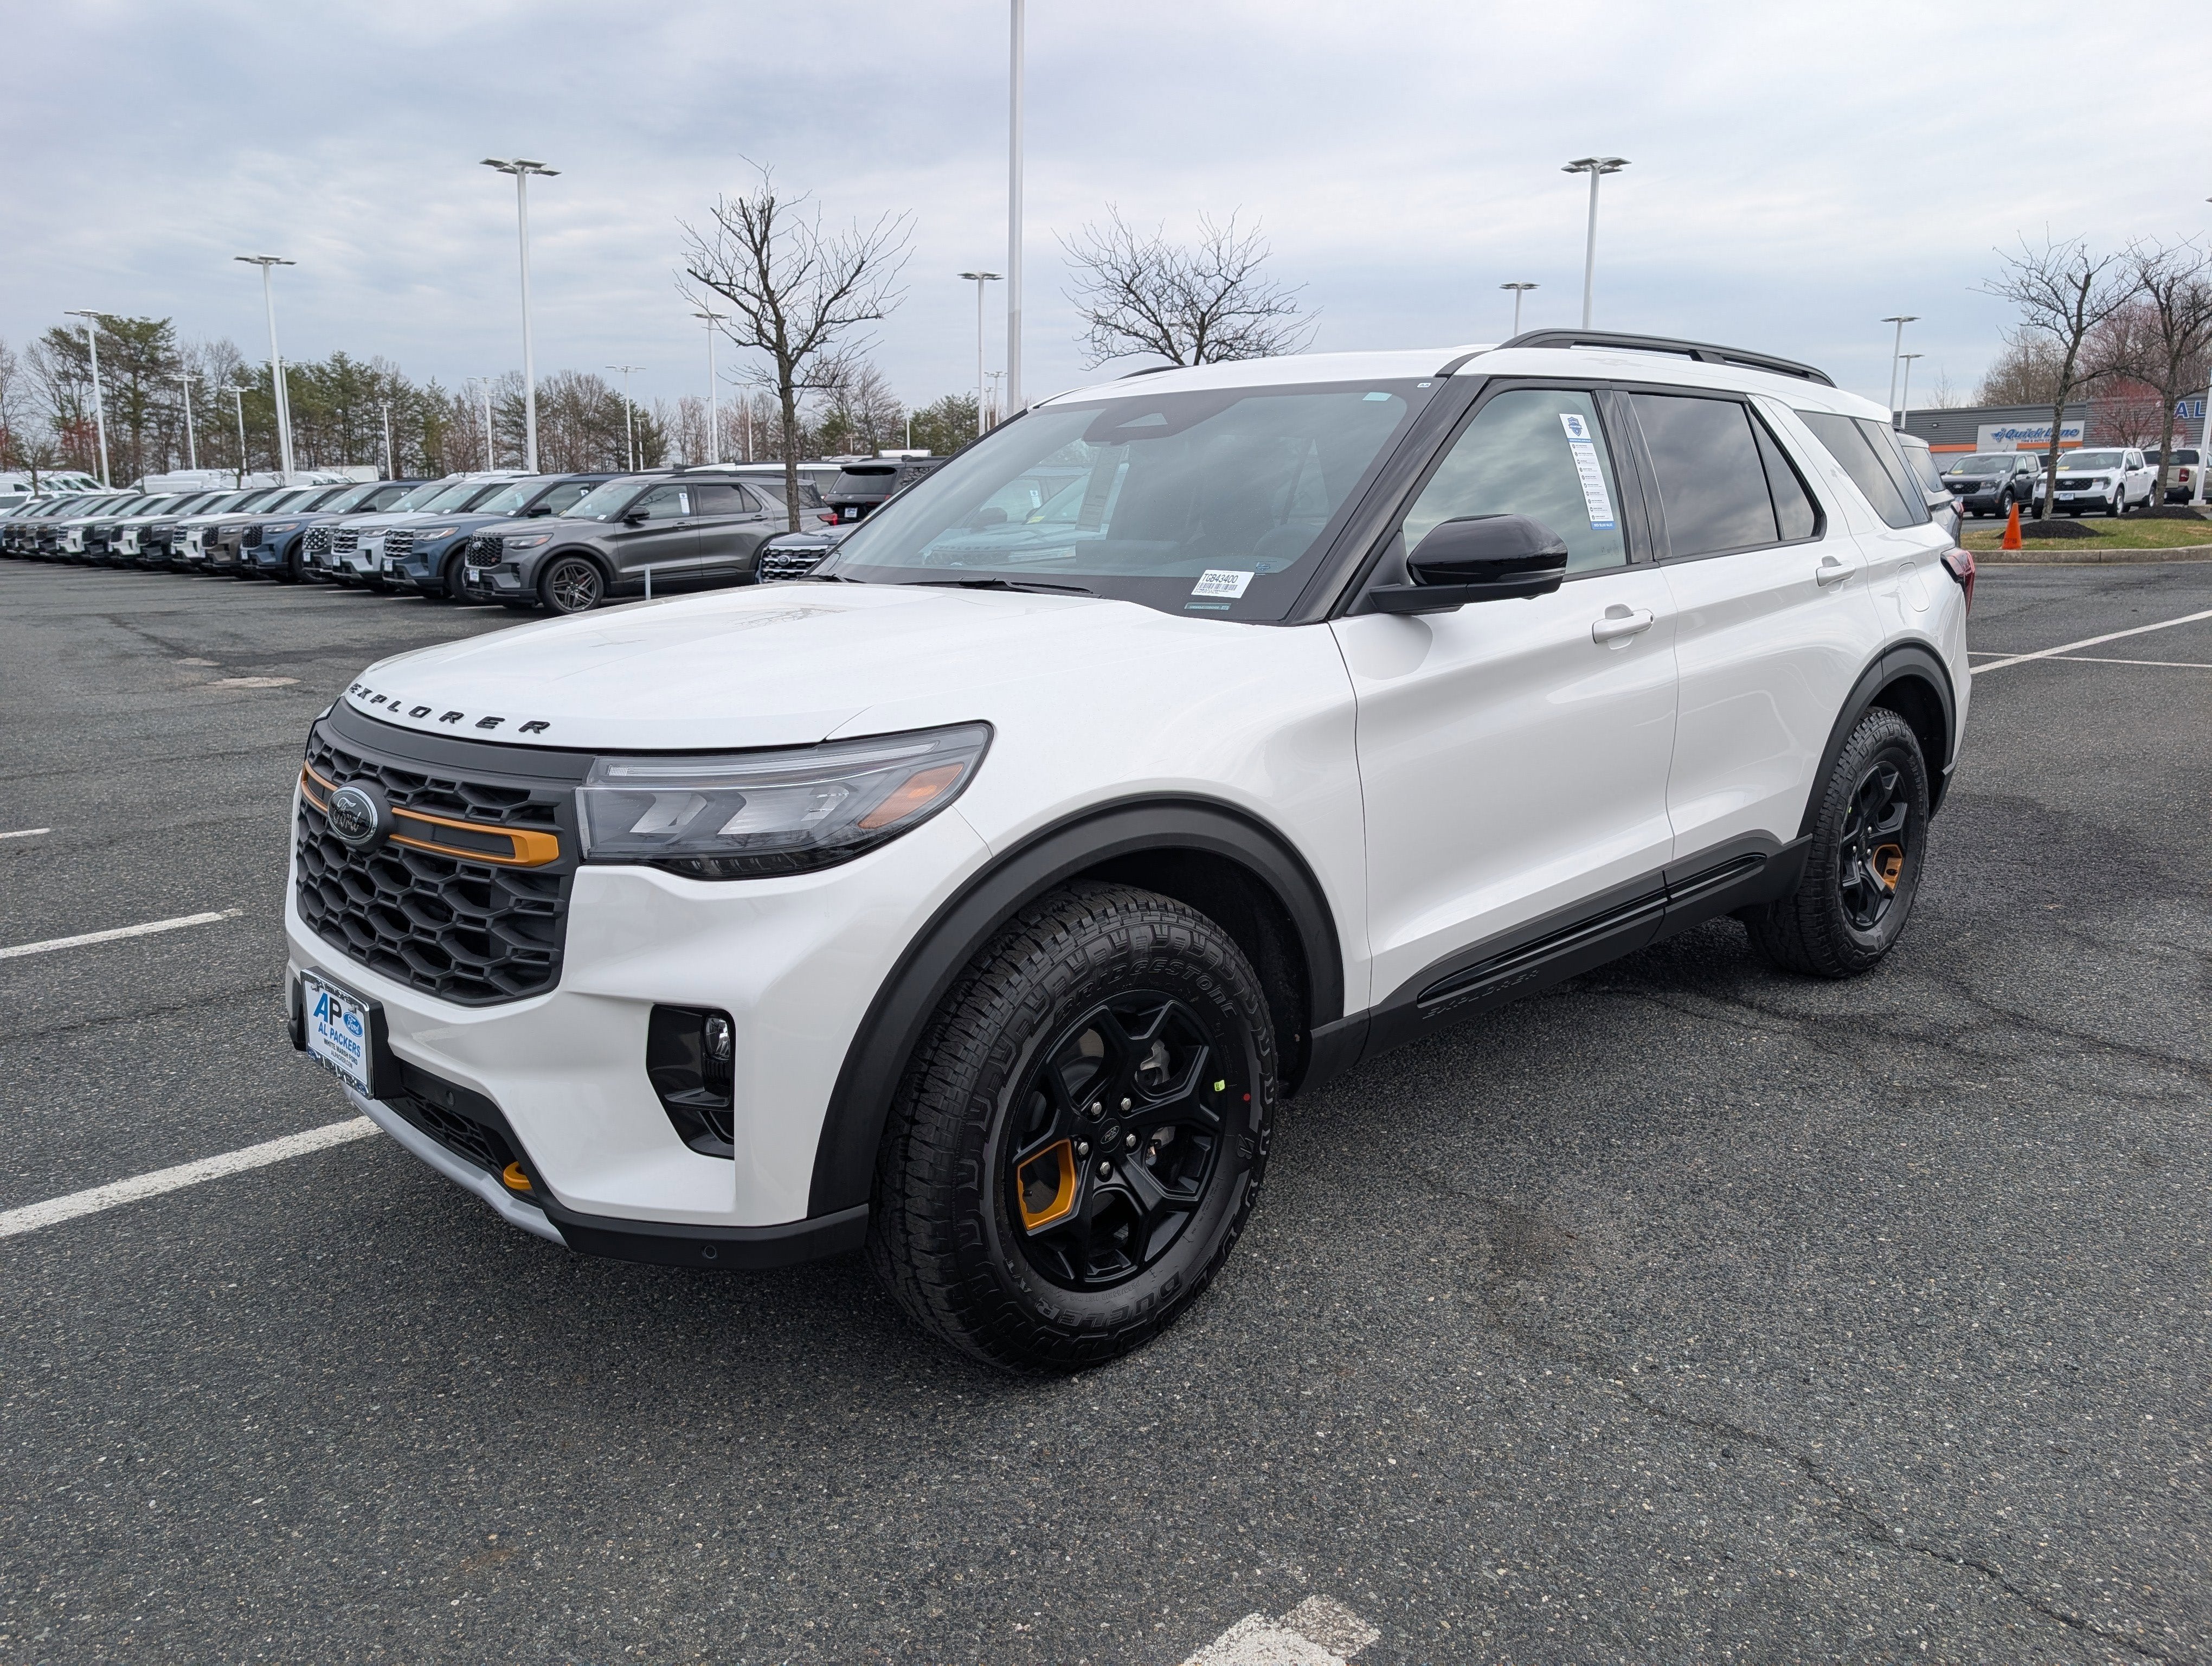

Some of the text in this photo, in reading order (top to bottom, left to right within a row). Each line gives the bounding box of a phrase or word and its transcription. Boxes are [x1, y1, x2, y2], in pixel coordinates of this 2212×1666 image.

[2044, 428, 2080, 438] Lne
[1202, 574, 1239, 584] TGB43400
[349, 683, 551, 734] EXPLORER
[332, 797, 362, 833] Ford
[313, 992, 342, 1026] AP
[348, 1014, 360, 1034] Ford
[318, 1021, 361, 1058] AL PACKERS
[323, 1037, 336, 1050] WHITE
[349, 1053, 358, 1066] FORD
[1034, 1270, 1182, 1329] DUELER
